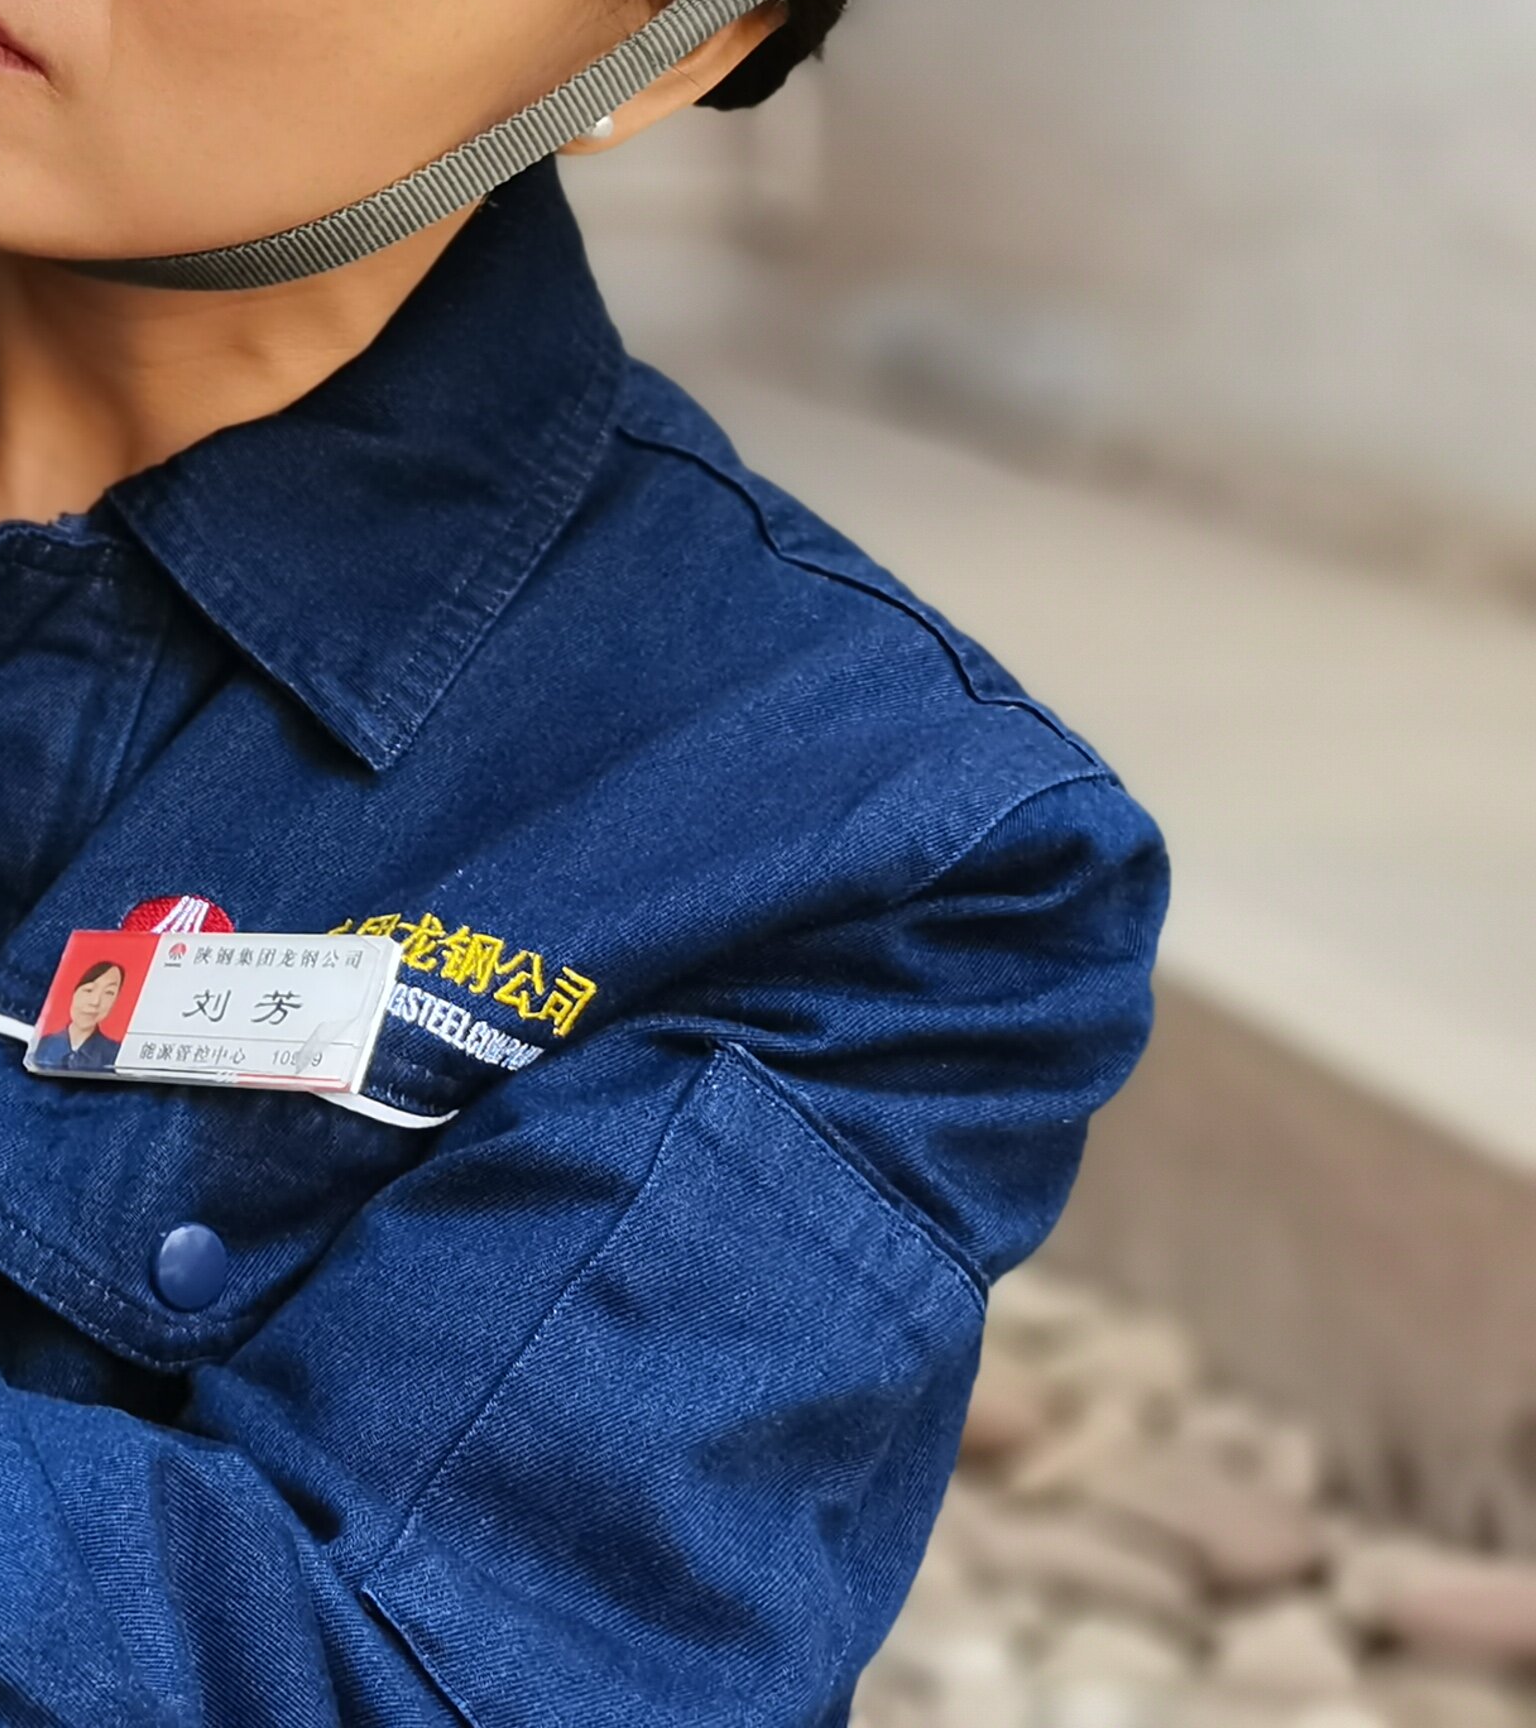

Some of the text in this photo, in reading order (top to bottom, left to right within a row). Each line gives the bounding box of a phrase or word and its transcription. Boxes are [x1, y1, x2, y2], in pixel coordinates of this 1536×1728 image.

[193, 946, 363, 970] 陕钢集团龙钢公司
[328, 912, 598, 1038] 龙钢公司
[140, 1041, 323, 1067] 能源管控中心 109
